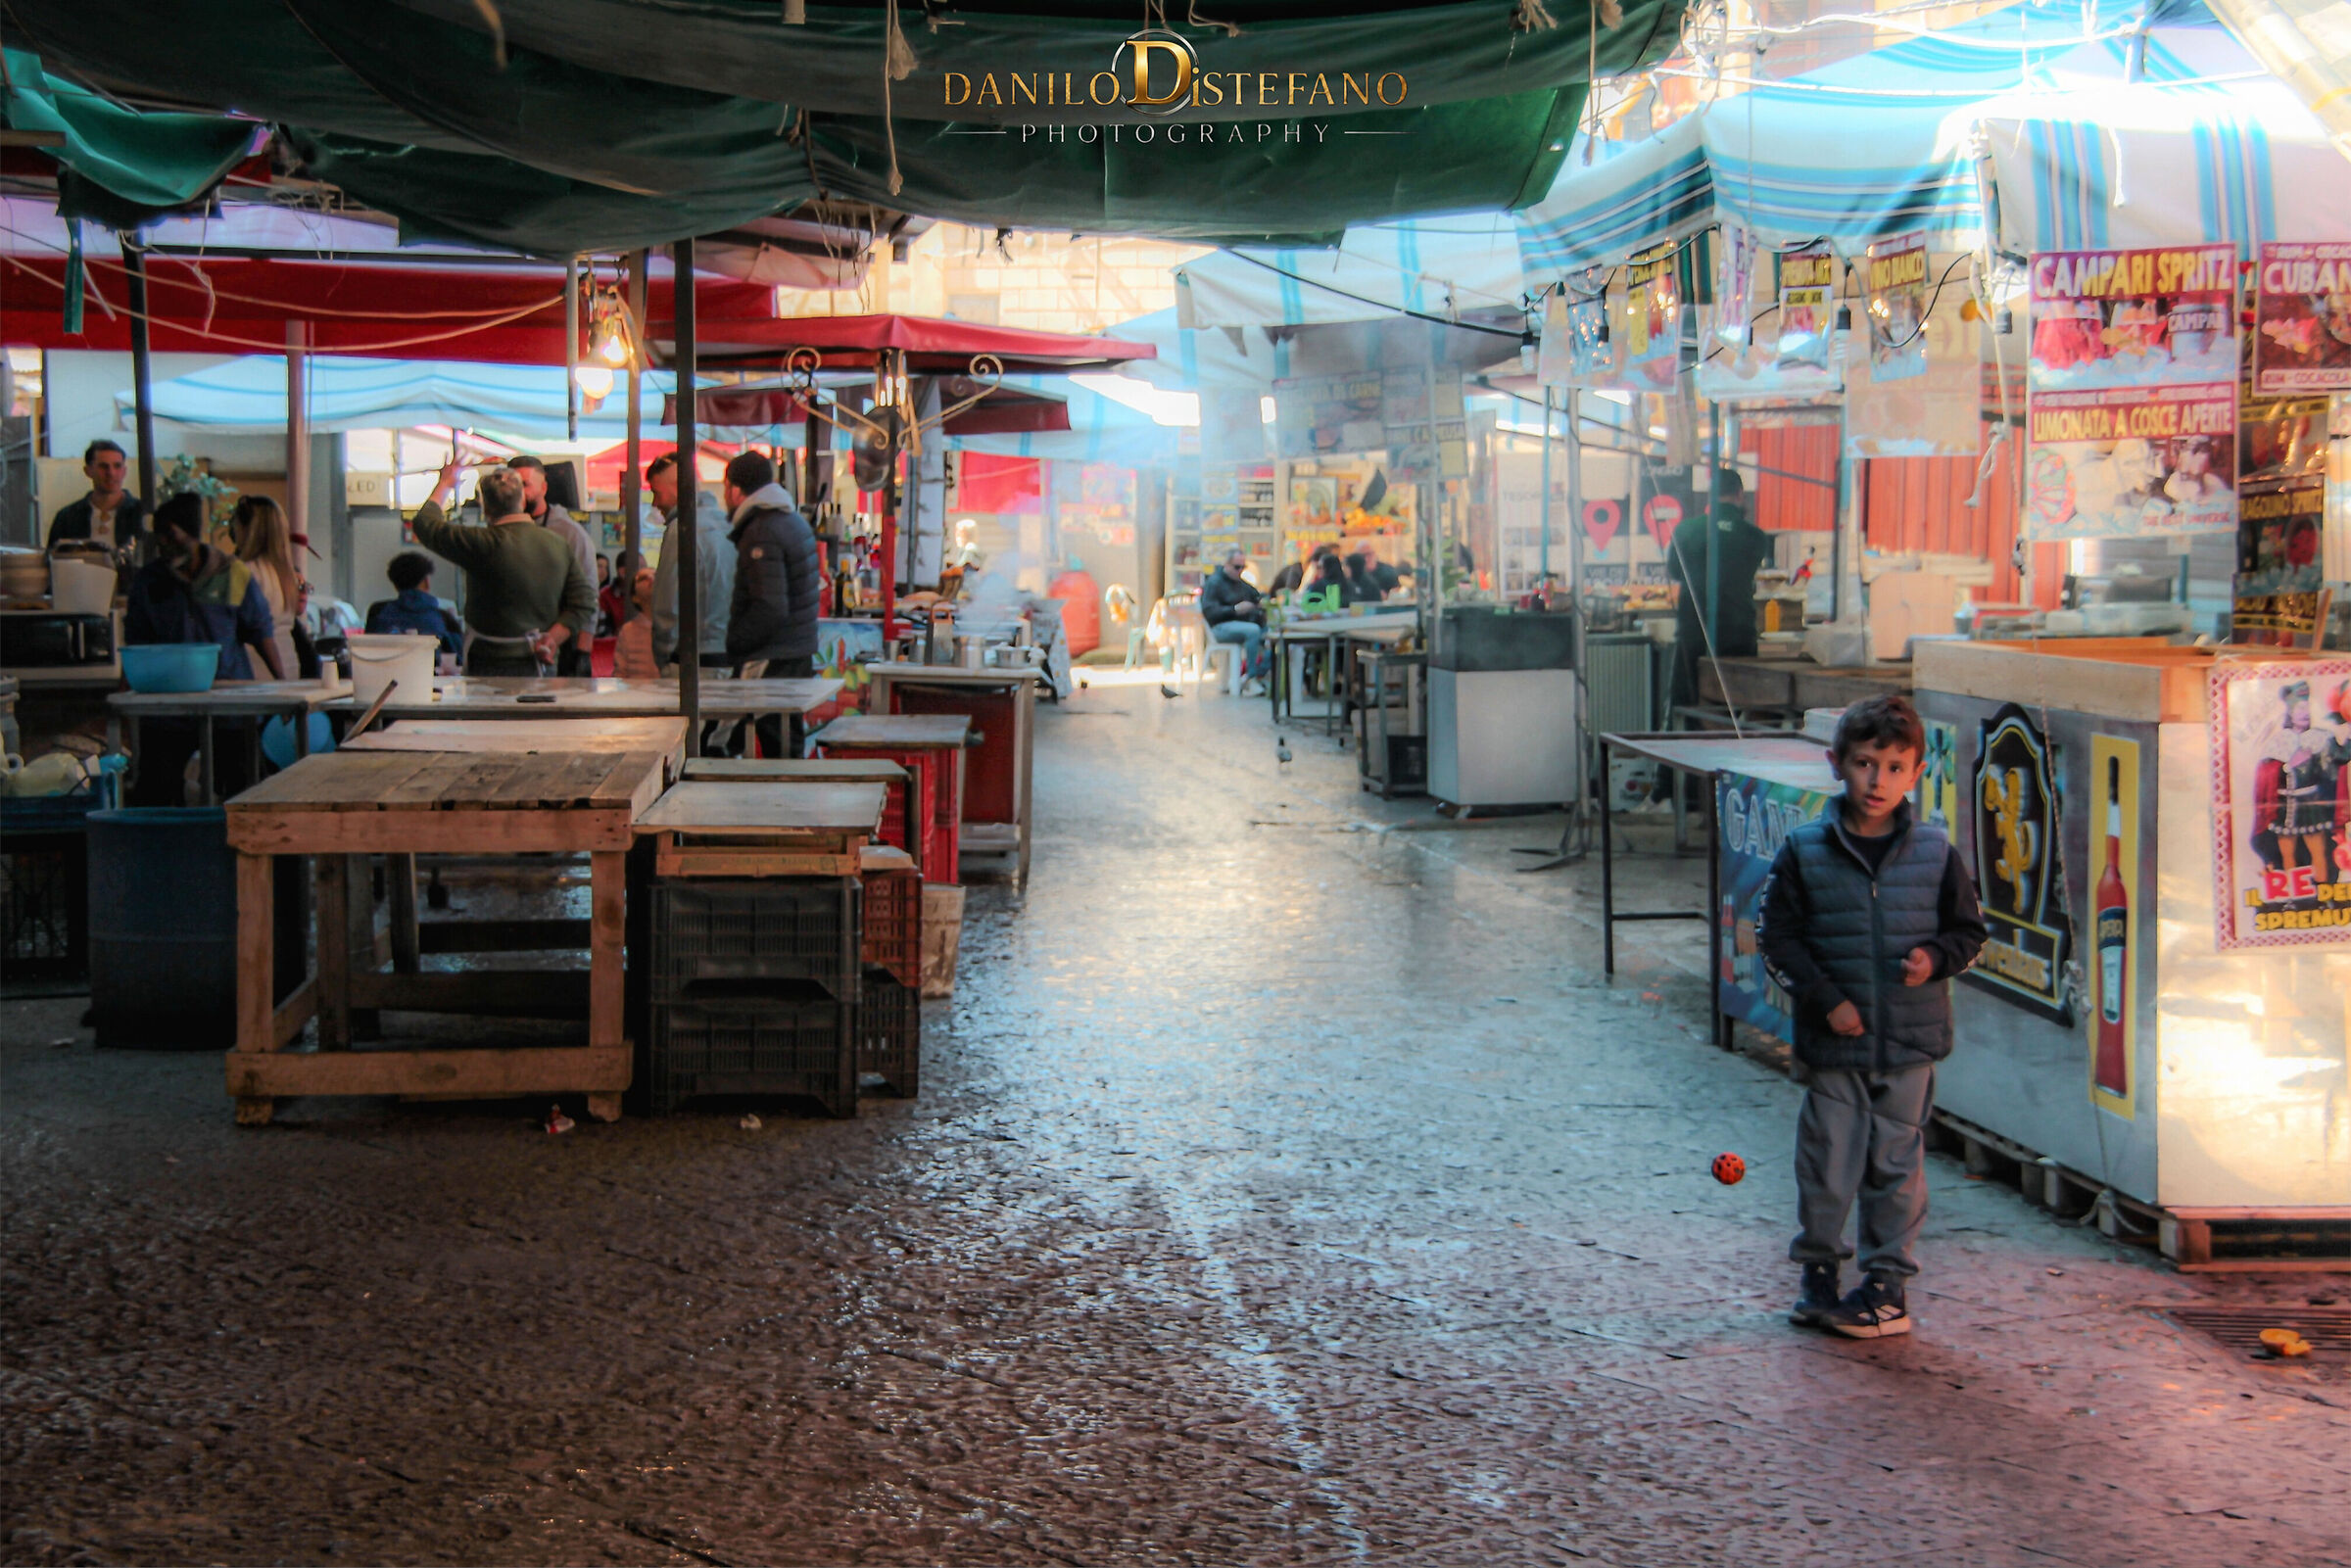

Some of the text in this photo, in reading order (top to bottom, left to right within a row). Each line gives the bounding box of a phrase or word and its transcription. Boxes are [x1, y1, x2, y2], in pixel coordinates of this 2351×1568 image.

[2034, 248, 2233, 299] CAMPARI SPRITZ
[2033, 406, 2112, 442] LIMONATA
[2114, 407, 2130, 439] A
[2130, 404, 2179, 437] COSCE
[2180, 400, 2232, 433] APERTE
[2243, 887, 2263, 907] IL
[2264, 865, 2317, 903] RE
